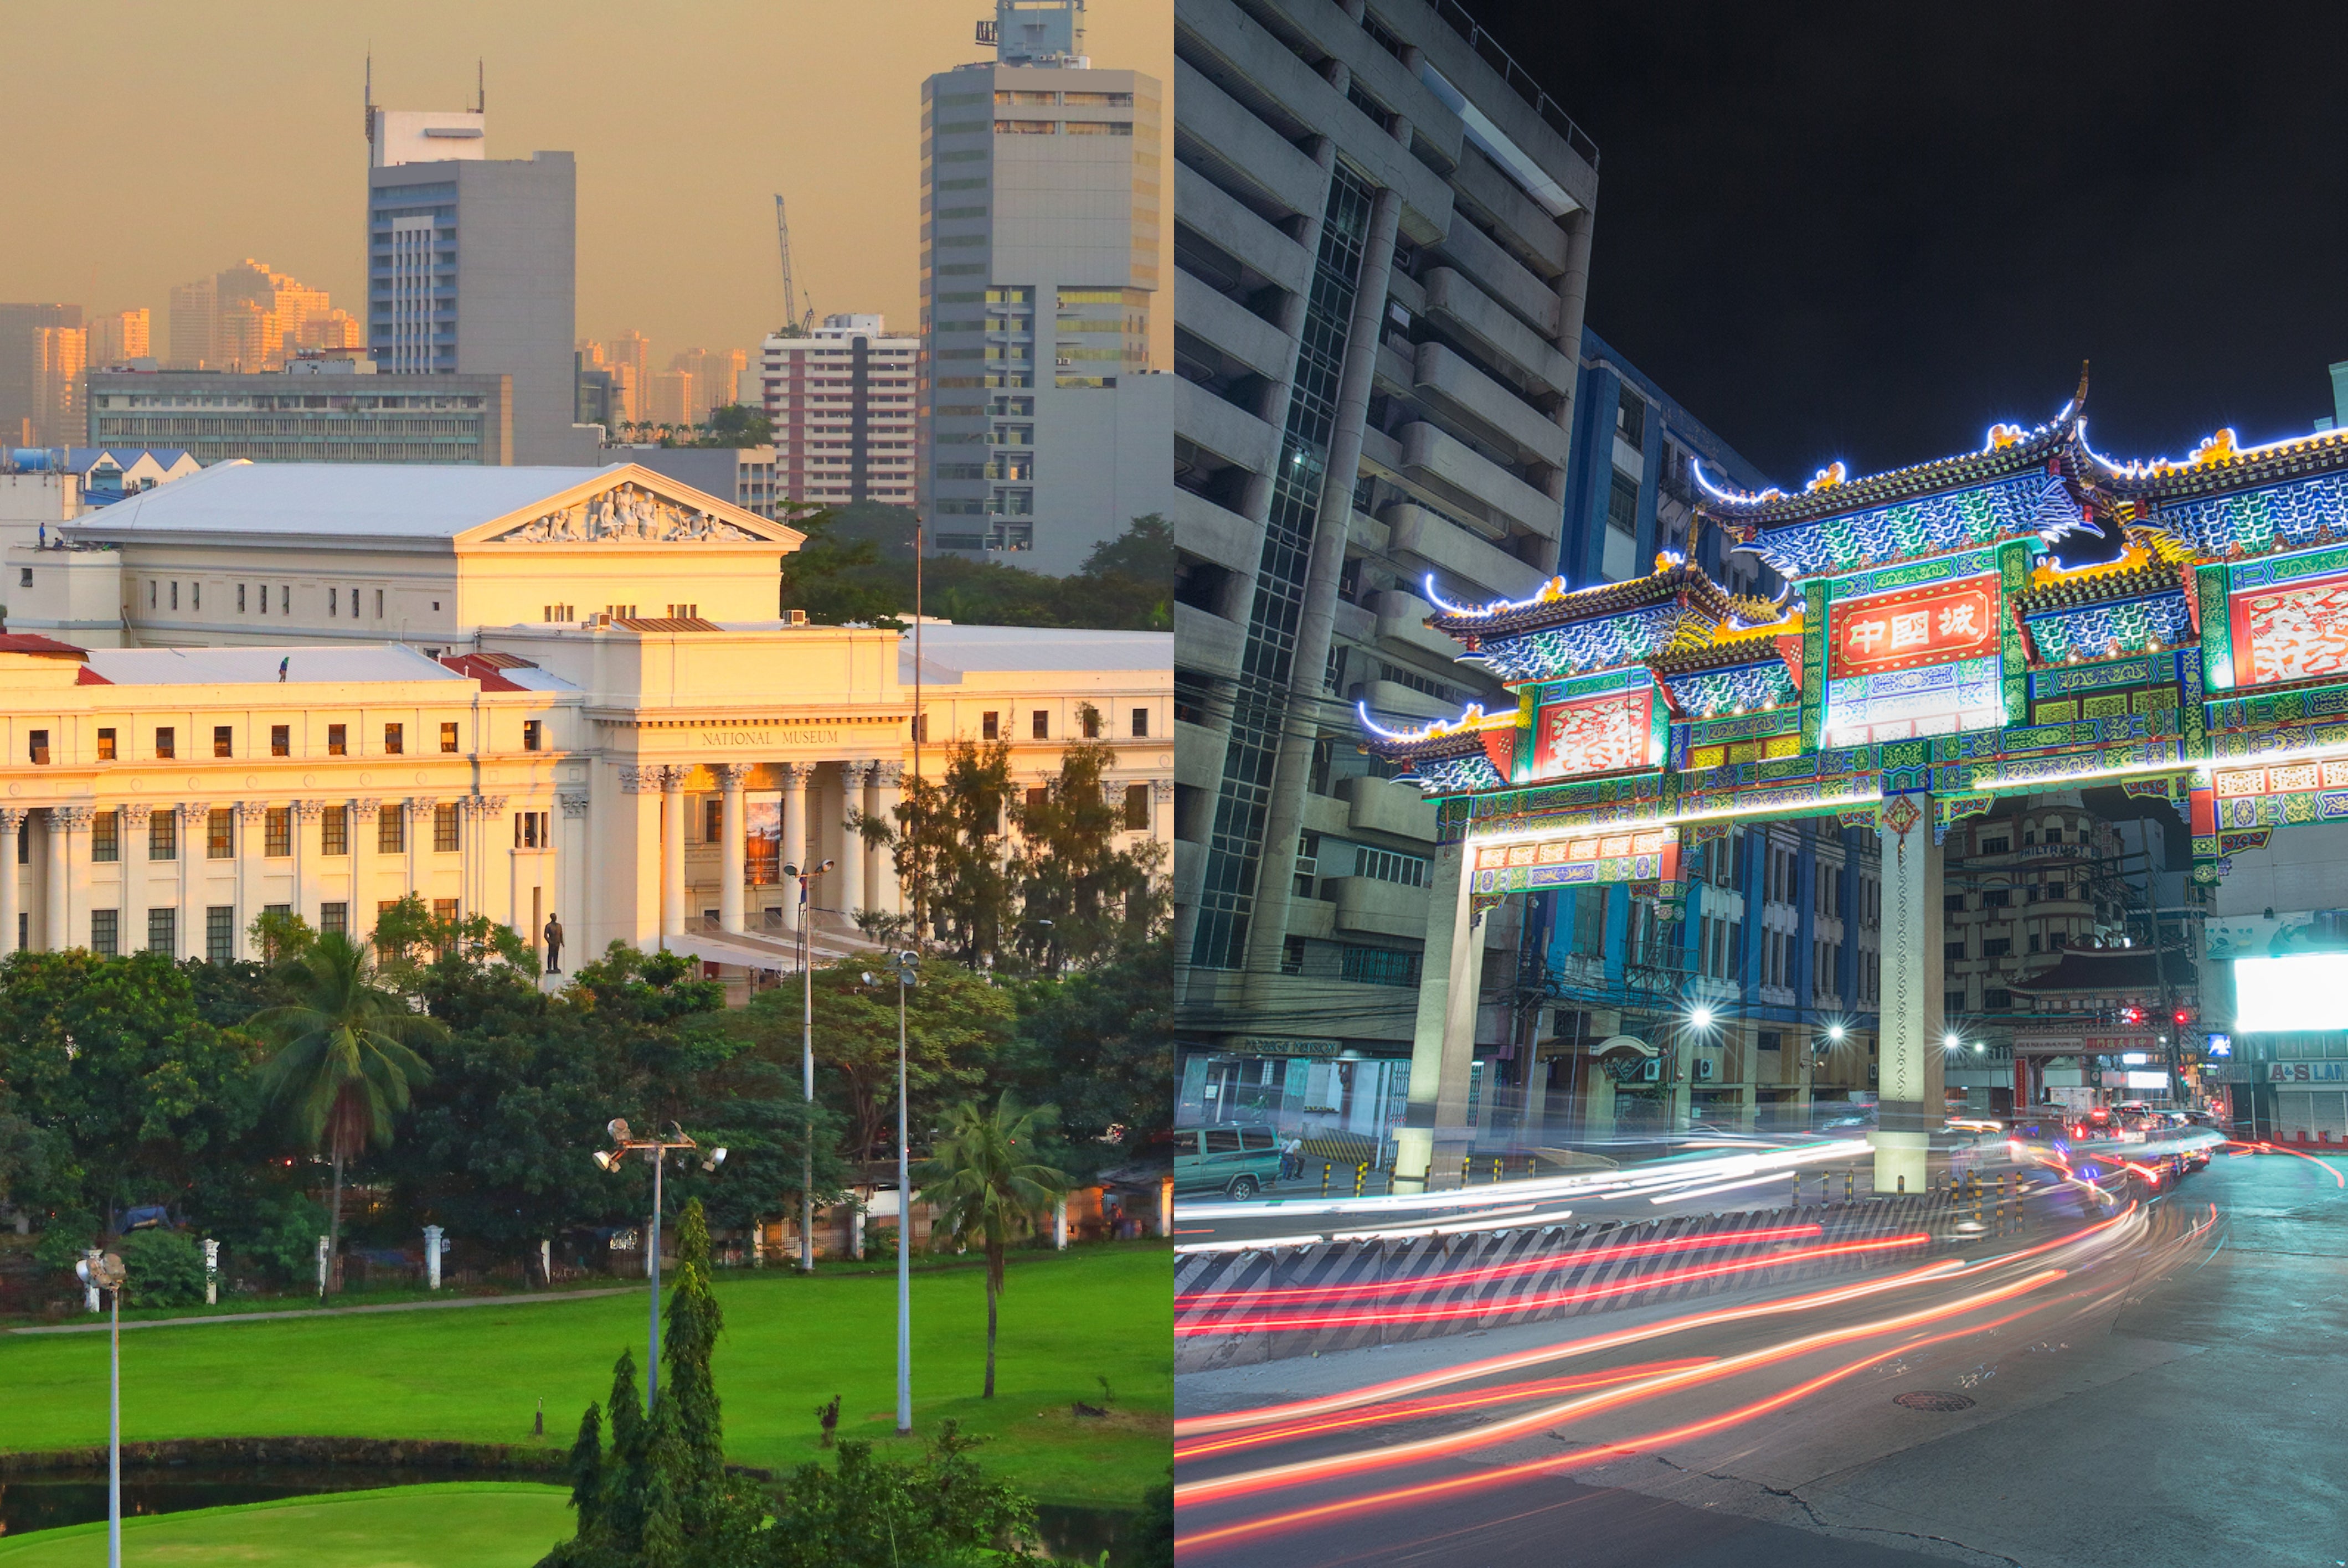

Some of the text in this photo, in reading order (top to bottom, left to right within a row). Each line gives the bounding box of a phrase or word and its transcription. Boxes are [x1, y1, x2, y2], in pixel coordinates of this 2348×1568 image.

[1850, 605, 1979, 653] 中國城
[702, 730, 838, 745] NATIONAL MUSEUM
[2020, 844, 2085, 859] PHILTRUST
[1294, 1041, 1335, 1054] MANSION
